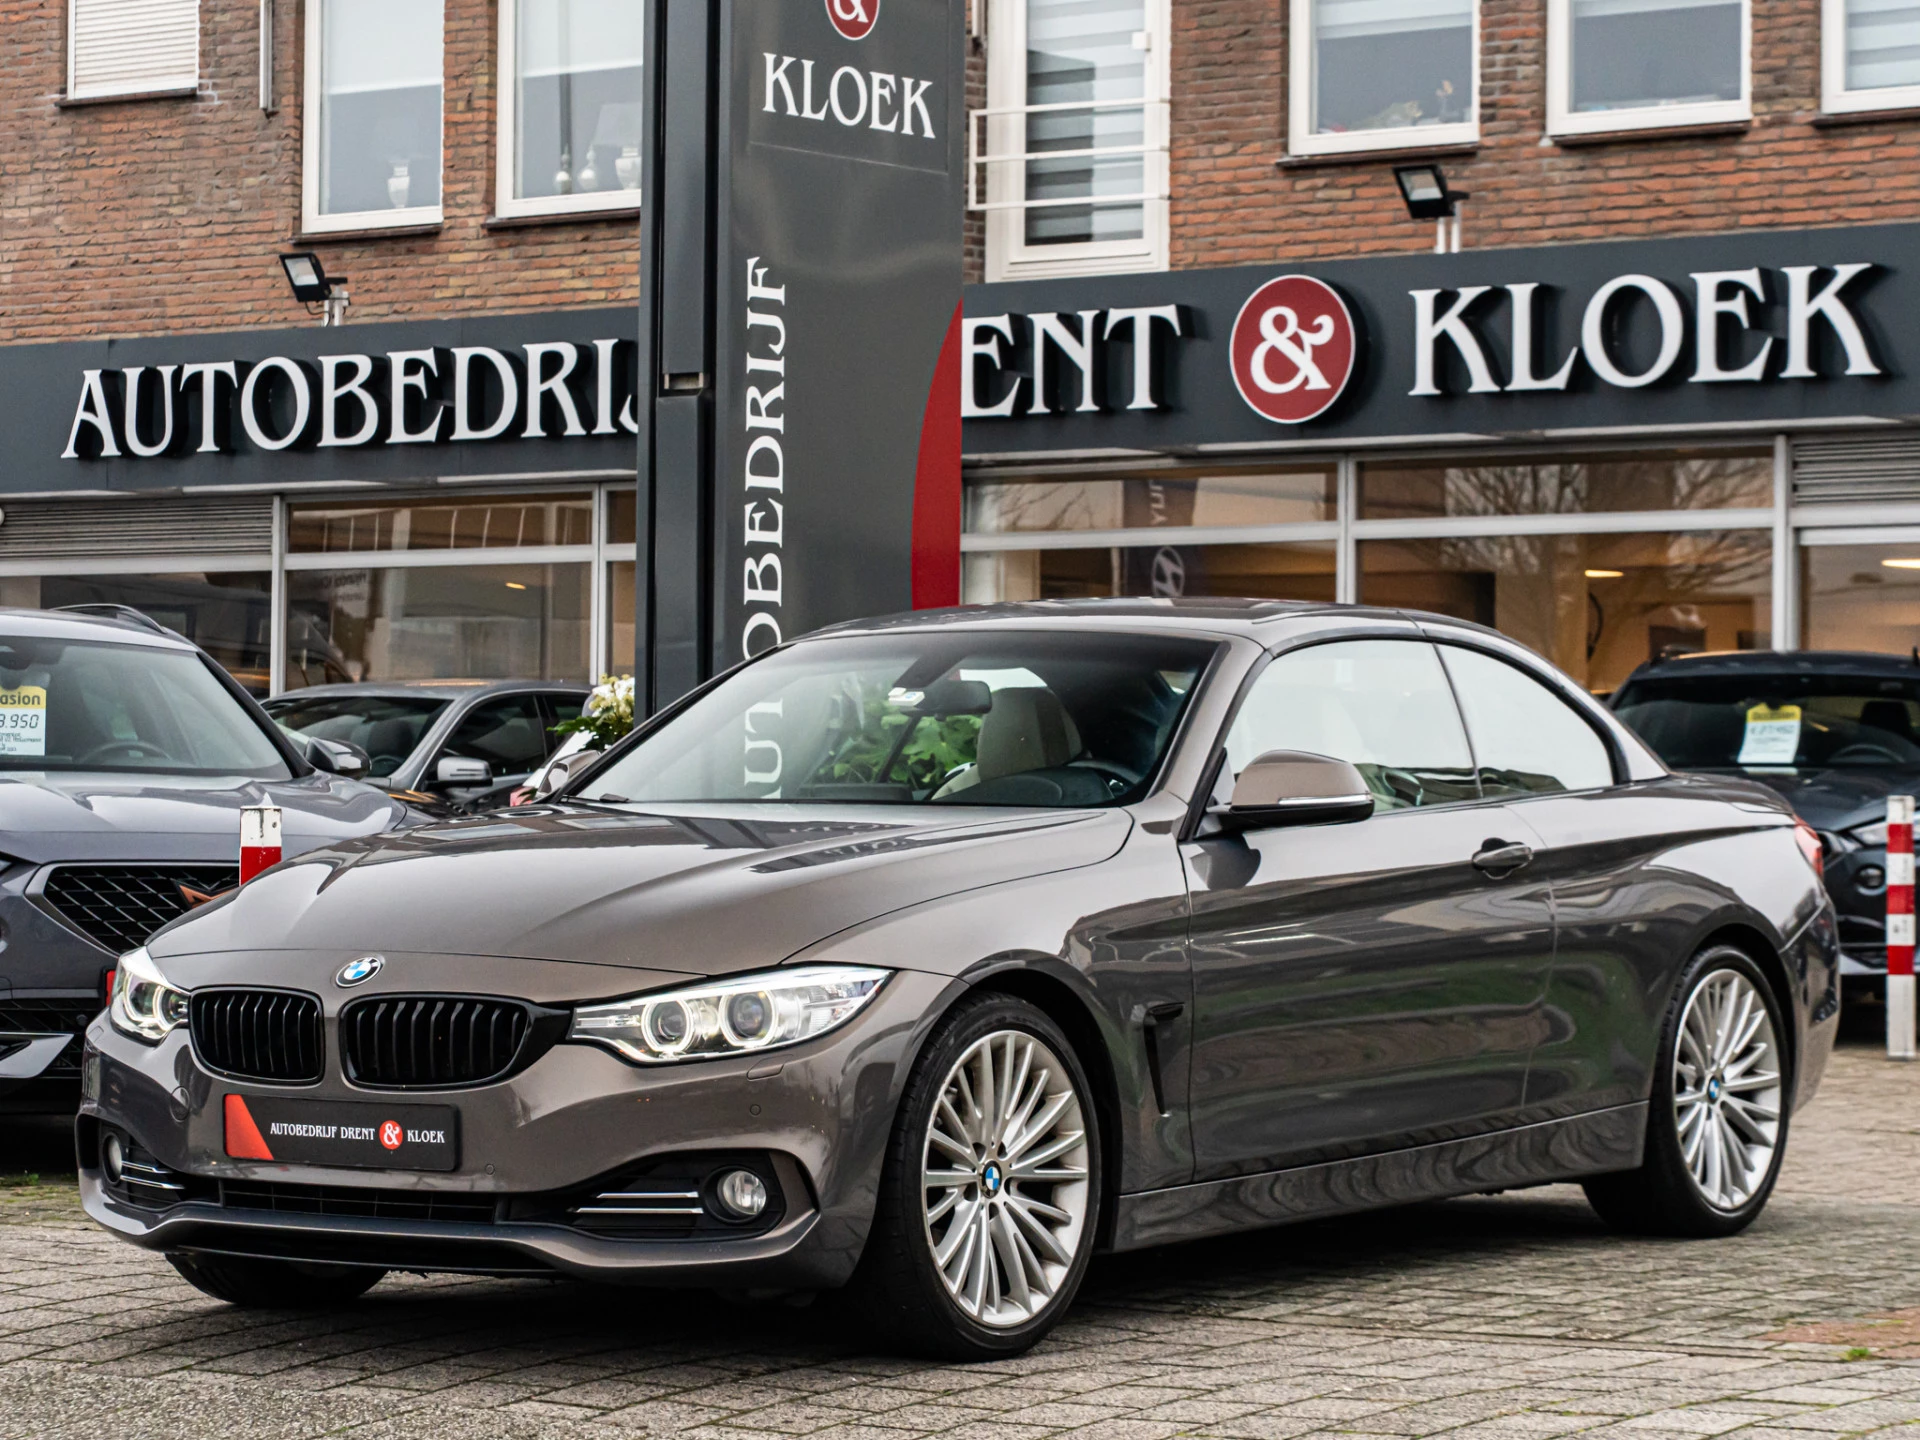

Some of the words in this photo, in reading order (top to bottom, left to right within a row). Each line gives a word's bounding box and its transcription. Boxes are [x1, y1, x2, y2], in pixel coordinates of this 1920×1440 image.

[763, 53, 936, 139] KLOEK
[1250, 305, 1334, 394] &
[1409, 263, 1880, 396] KLOEK
[742, 256, 787, 799] UTOBEDRIJF
[270, 1122, 337, 1139] AUTOBEDRIJF
[340, 1126, 375, 1141] DRENT
[383, 1123, 400, 1146] &
[407, 1129, 445, 1144] KLOEK
